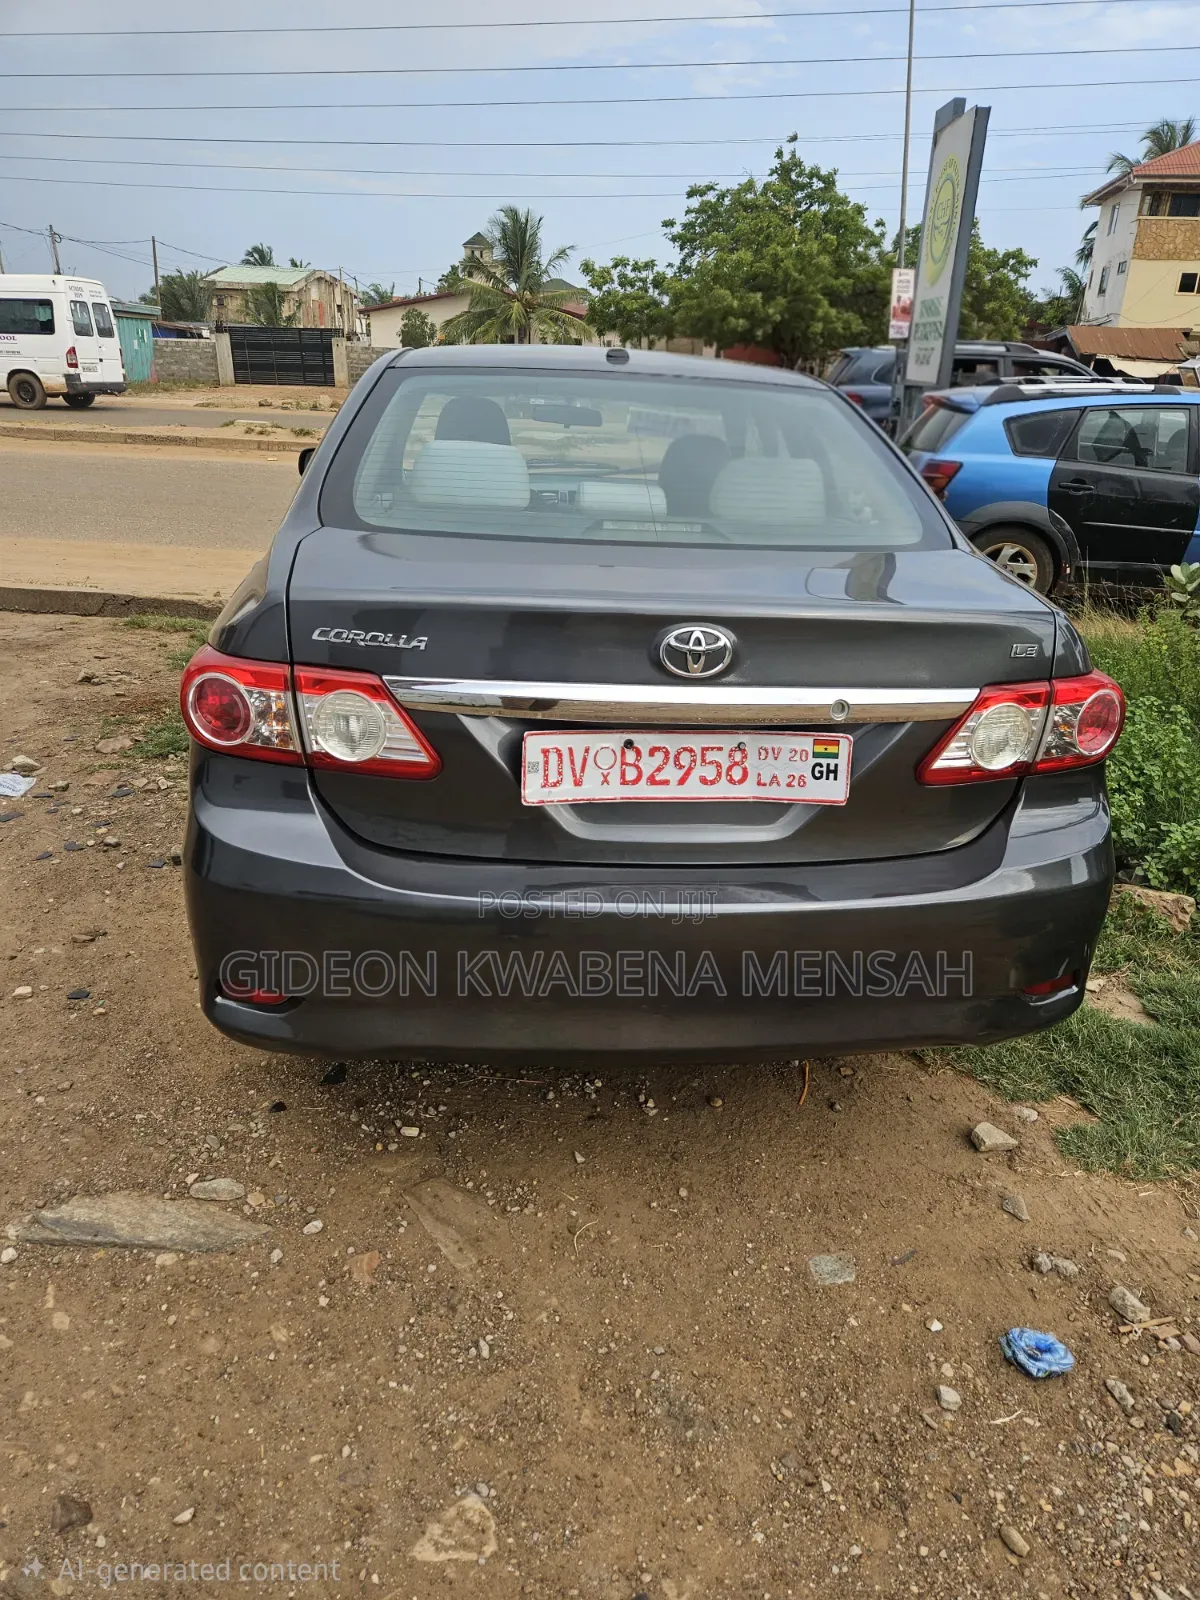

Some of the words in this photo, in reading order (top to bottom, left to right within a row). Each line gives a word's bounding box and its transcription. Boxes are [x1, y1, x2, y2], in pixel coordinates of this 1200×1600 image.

[311, 627, 429, 651] COROLLA
[757, 745, 782, 761] DV
[788, 747, 809, 763] 20
[540, 745, 590, 789] DV
[620, 745, 749, 786] B2958
[811, 761, 839, 782] GH
[756, 772, 782, 787] LA
[786, 773, 807, 788] 26
